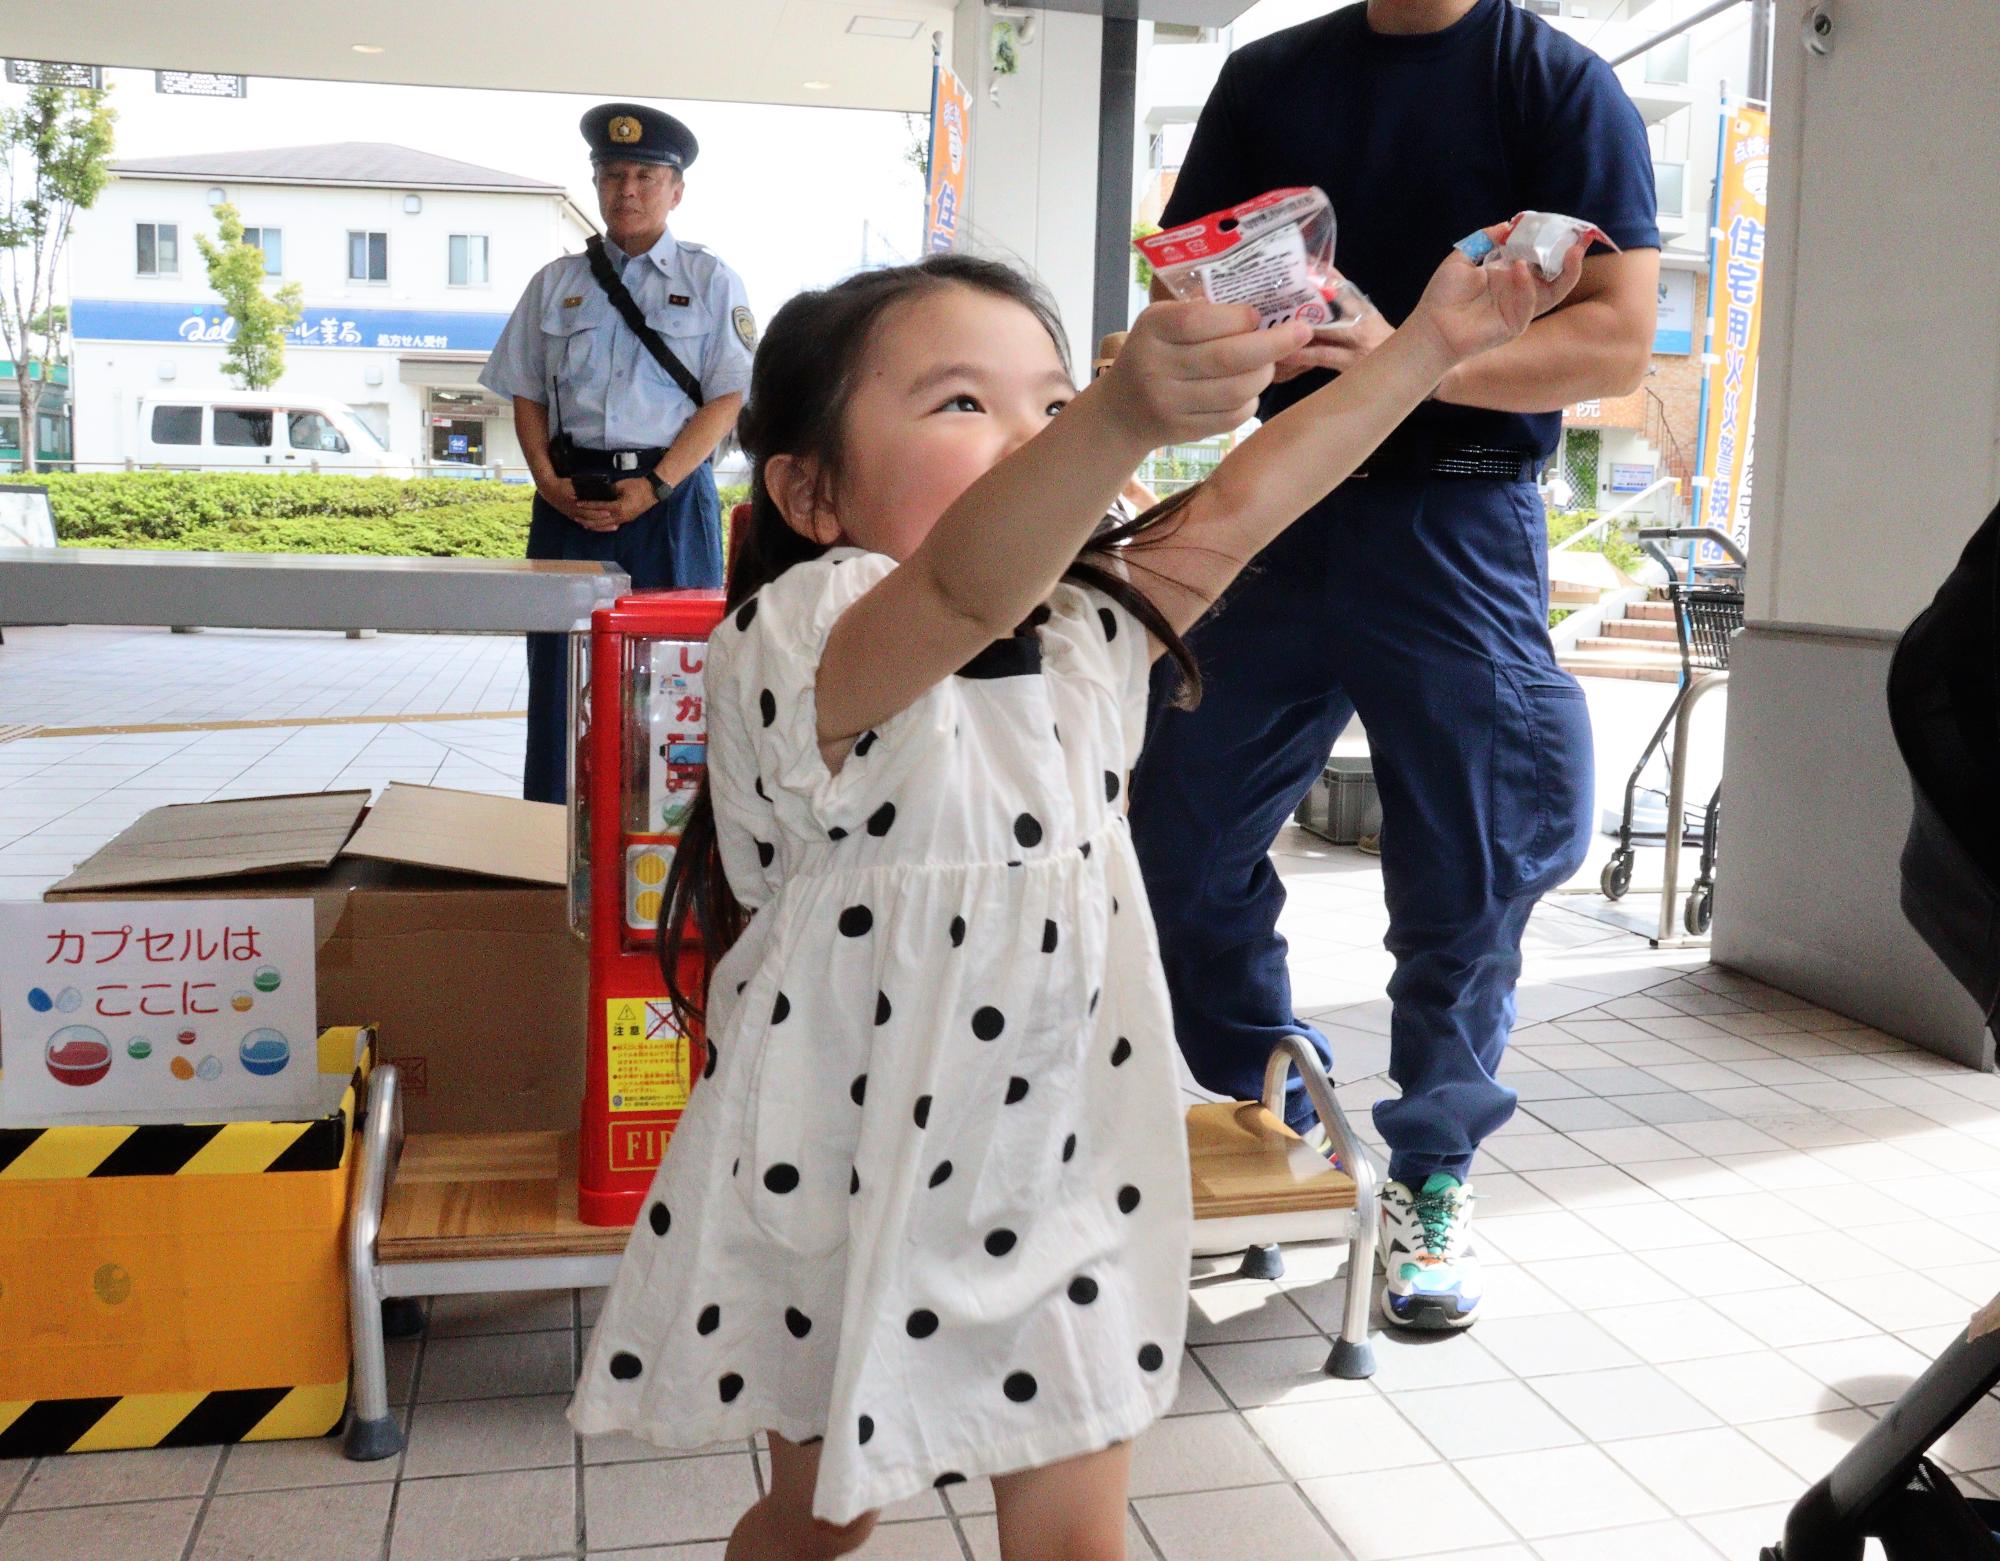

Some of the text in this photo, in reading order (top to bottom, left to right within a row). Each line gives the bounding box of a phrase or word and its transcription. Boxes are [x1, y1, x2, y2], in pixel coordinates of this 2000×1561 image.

[272, 316, 362, 344] ール薬局
[377, 333, 448, 348] 処方せん受付
[46, 924, 262, 964] カプセルは
[96, 981, 219, 1017] ここに
[613, 1025, 641, 1036] 注意
